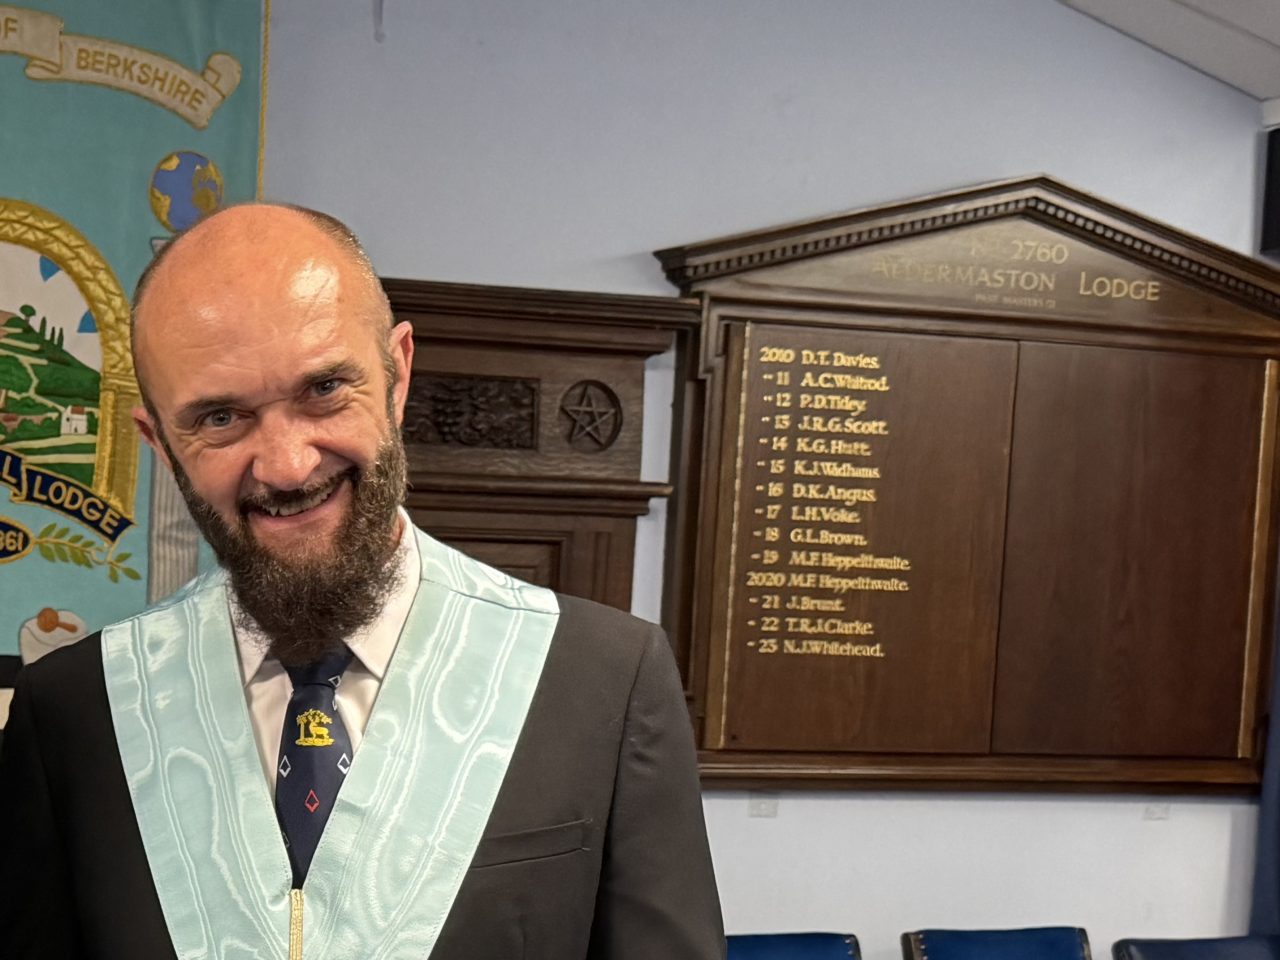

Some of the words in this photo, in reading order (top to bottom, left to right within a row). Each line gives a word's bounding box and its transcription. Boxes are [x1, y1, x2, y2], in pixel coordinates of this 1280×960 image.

[76, 48, 205, 112] BERKSHIRE
[1010, 240, 1069, 264] 2760
[1079, 271, 1161, 301] LODGE
[759, 347, 795, 363] 2010
[776, 393, 791, 407] 12
[772, 436, 788, 451] 14
[770, 459, 786, 474] 15
[768, 482, 784, 497] 16
[33, 475, 121, 536] LODGE
[766, 504, 781, 519] 17
[765, 527, 780, 542] 18
[763, 550, 779, 564] 19
[746, 571, 786, 586] 2020
[761, 595, 780, 609] 21
[760, 617, 779, 631] 22
